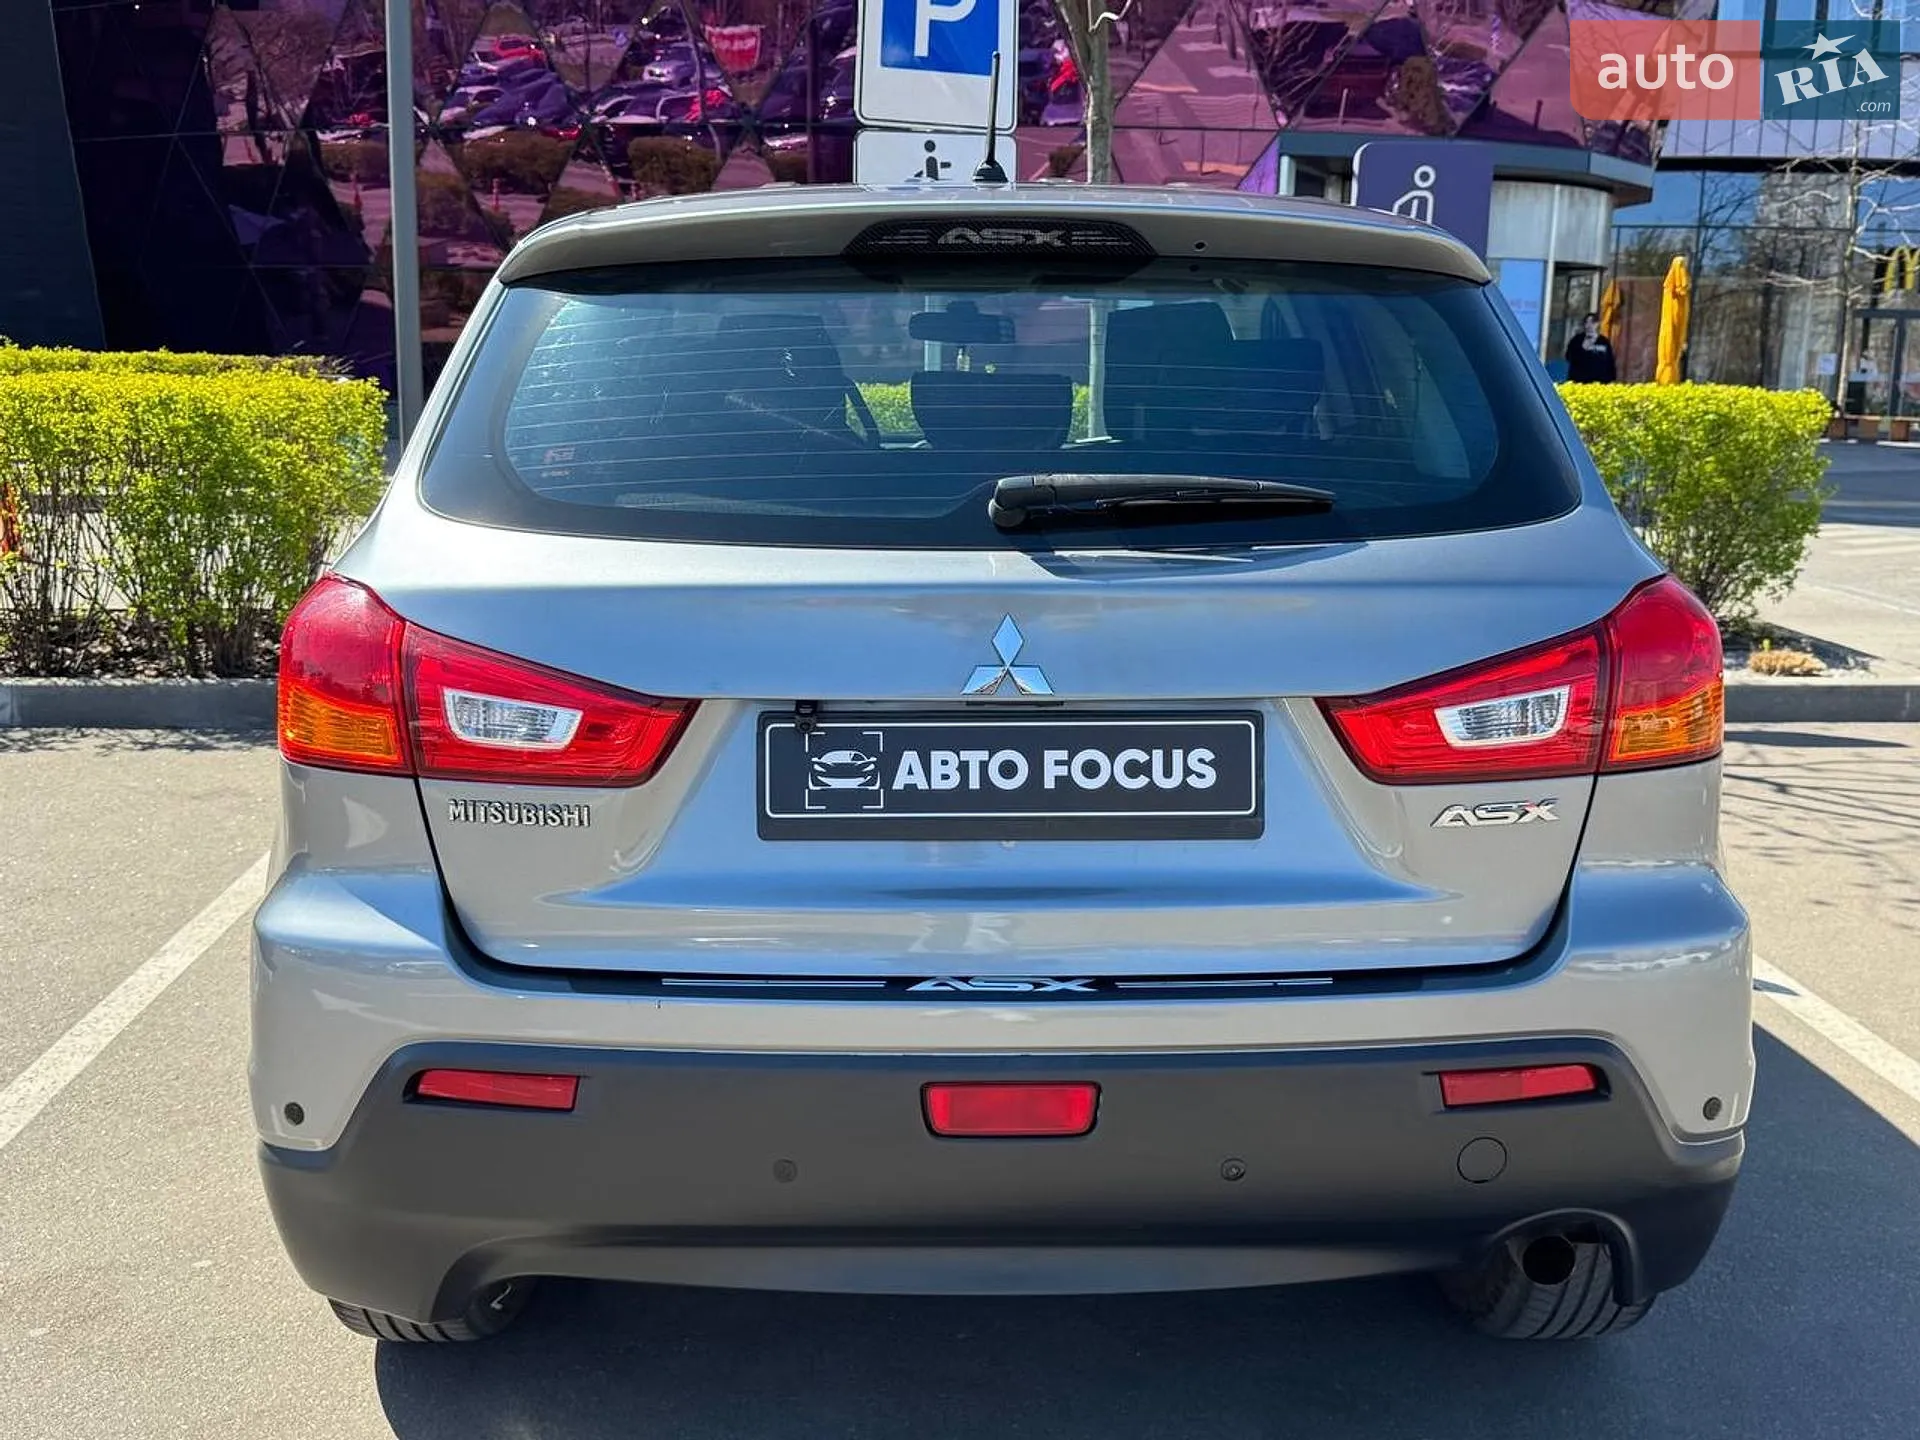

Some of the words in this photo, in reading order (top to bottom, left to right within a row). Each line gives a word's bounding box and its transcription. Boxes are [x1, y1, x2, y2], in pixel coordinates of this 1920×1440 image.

[914, 0, 978, 57] P
[937, 227, 1067, 247] ASX
[892, 750, 1029, 790] АВТО
[1043, 748, 1217, 790] FOCUS
[448, 799, 592, 827] MITSUBISHI
[1430, 798, 1560, 828] ASX
[906, 976, 1098, 992] ASX
